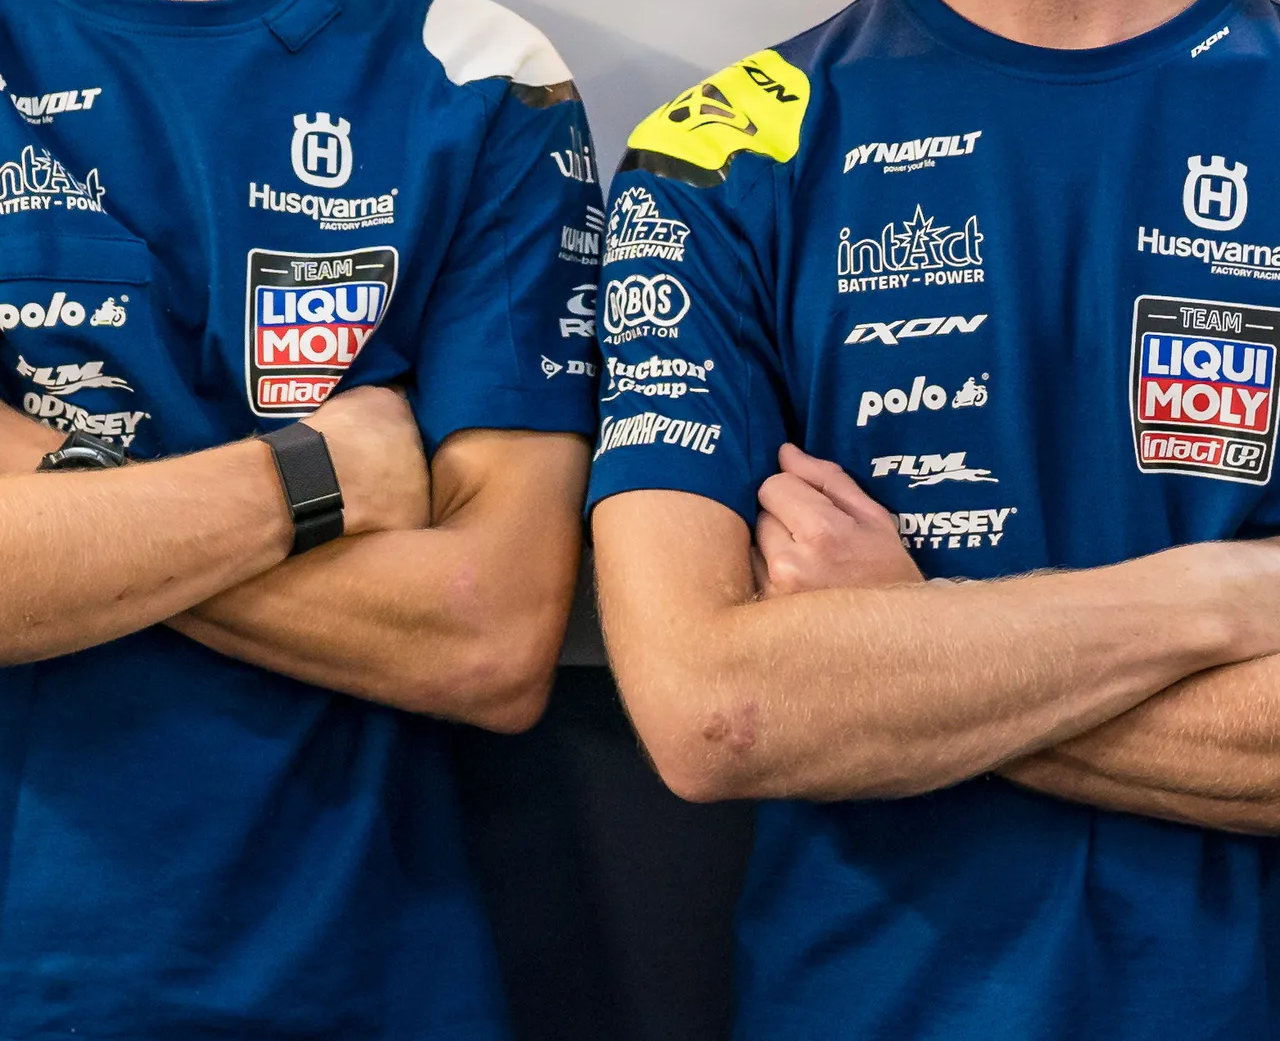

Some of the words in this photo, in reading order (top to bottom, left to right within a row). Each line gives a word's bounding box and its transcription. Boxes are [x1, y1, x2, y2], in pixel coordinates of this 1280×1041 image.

[843, 130, 982, 174] DYNAVOLT
[249, 182, 394, 221] Husqvarna
[320, 220, 361, 231] FACTORY
[361, 215, 395, 228] RACING
[291, 259, 354, 281] TEAM
[837, 273, 909, 294] BATTERY
[924, 267, 985, 287] POWER
[1210, 265, 1252, 279] FACTORY
[262, 286, 381, 325] LIQUI
[1179, 306, 1243, 334] TEAM
[16, 355, 105, 386] FLM
[1147, 337, 1268, 385] LIQUI
[618, 378, 687, 398] Group
[856, 375, 948, 427] polo
[23, 391, 145, 436] ODYSSEY
[1144, 380, 1270, 428] MOLY
[871, 451, 967, 478] FLM
